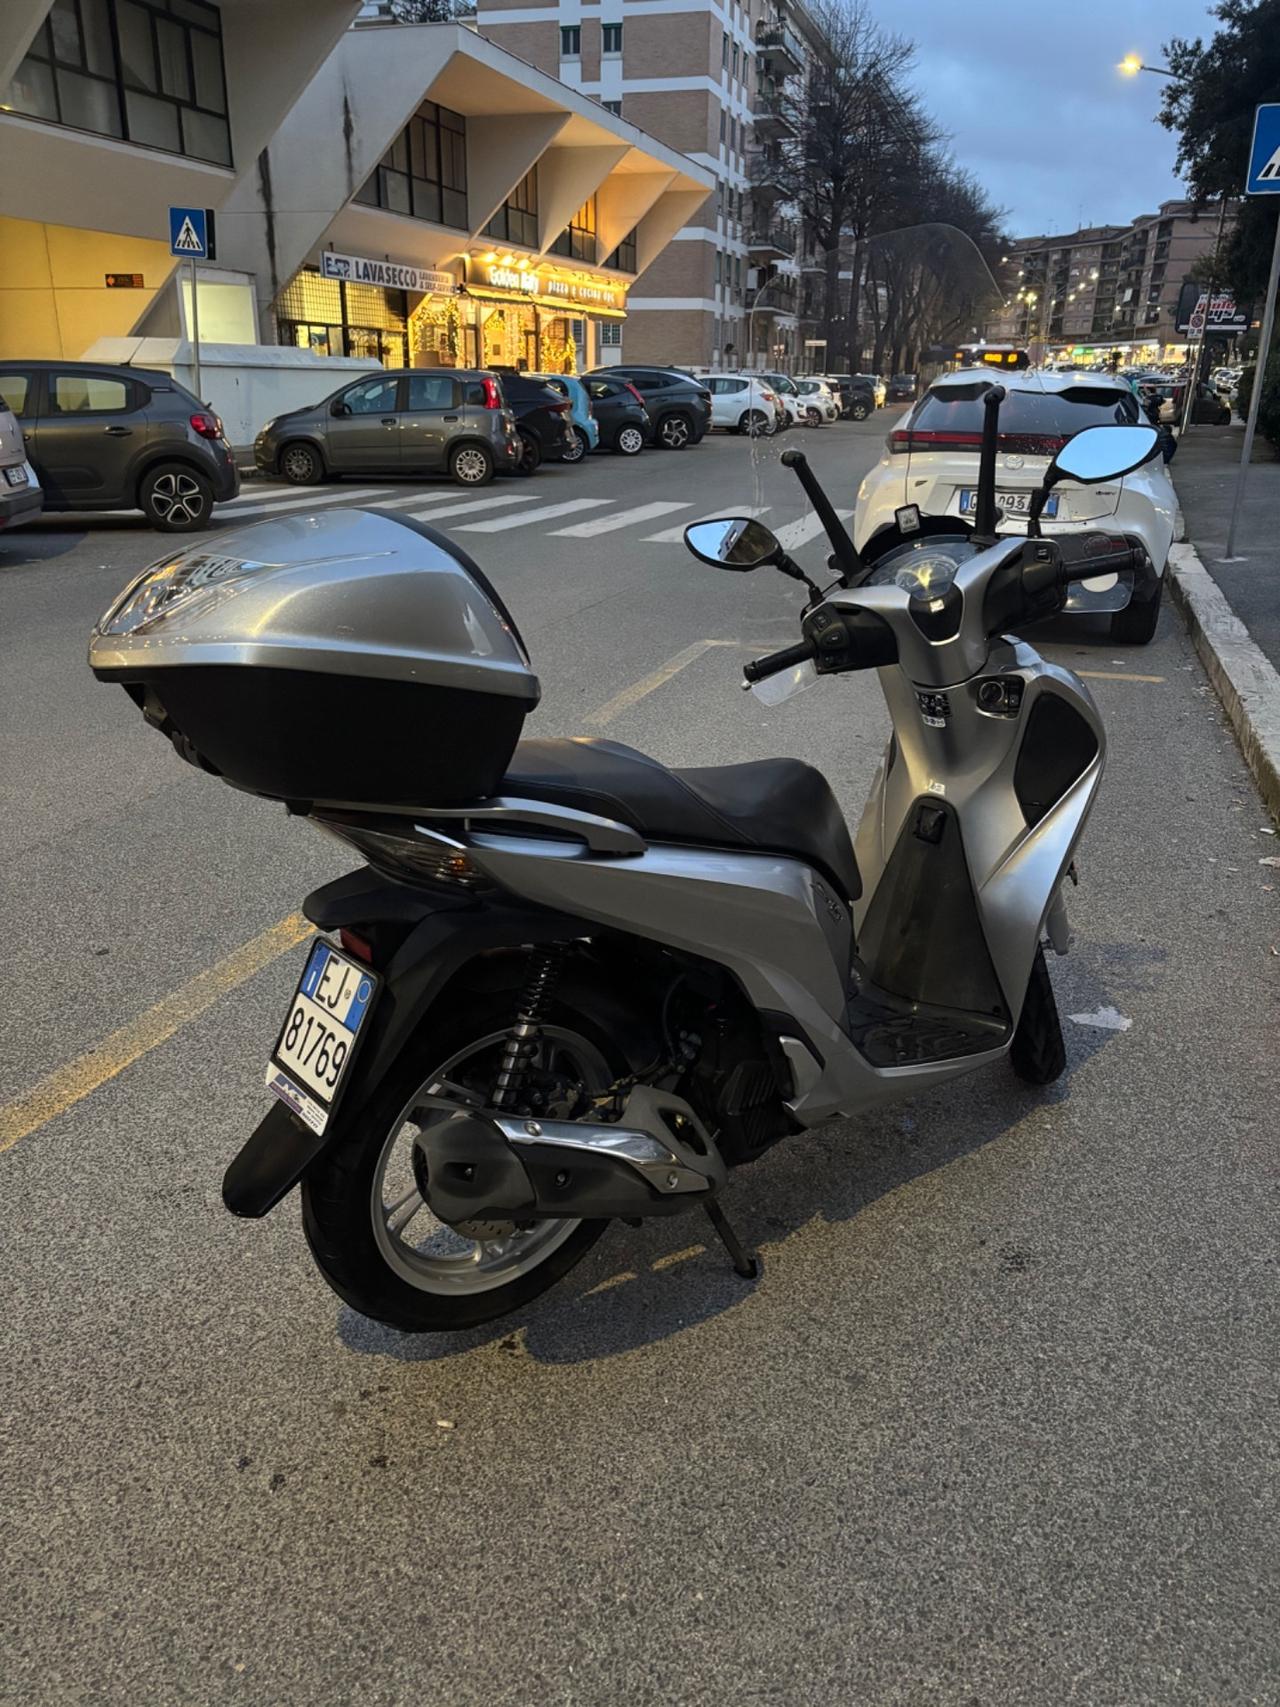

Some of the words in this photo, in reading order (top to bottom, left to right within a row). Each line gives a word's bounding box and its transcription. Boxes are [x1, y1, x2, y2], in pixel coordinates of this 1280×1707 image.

[355, 260, 417, 289] LAVASECCO
[548, 280, 568, 295] pizza
[314, 953, 351, 1009] EJ
[285, 1007, 348, 1088] 81769
